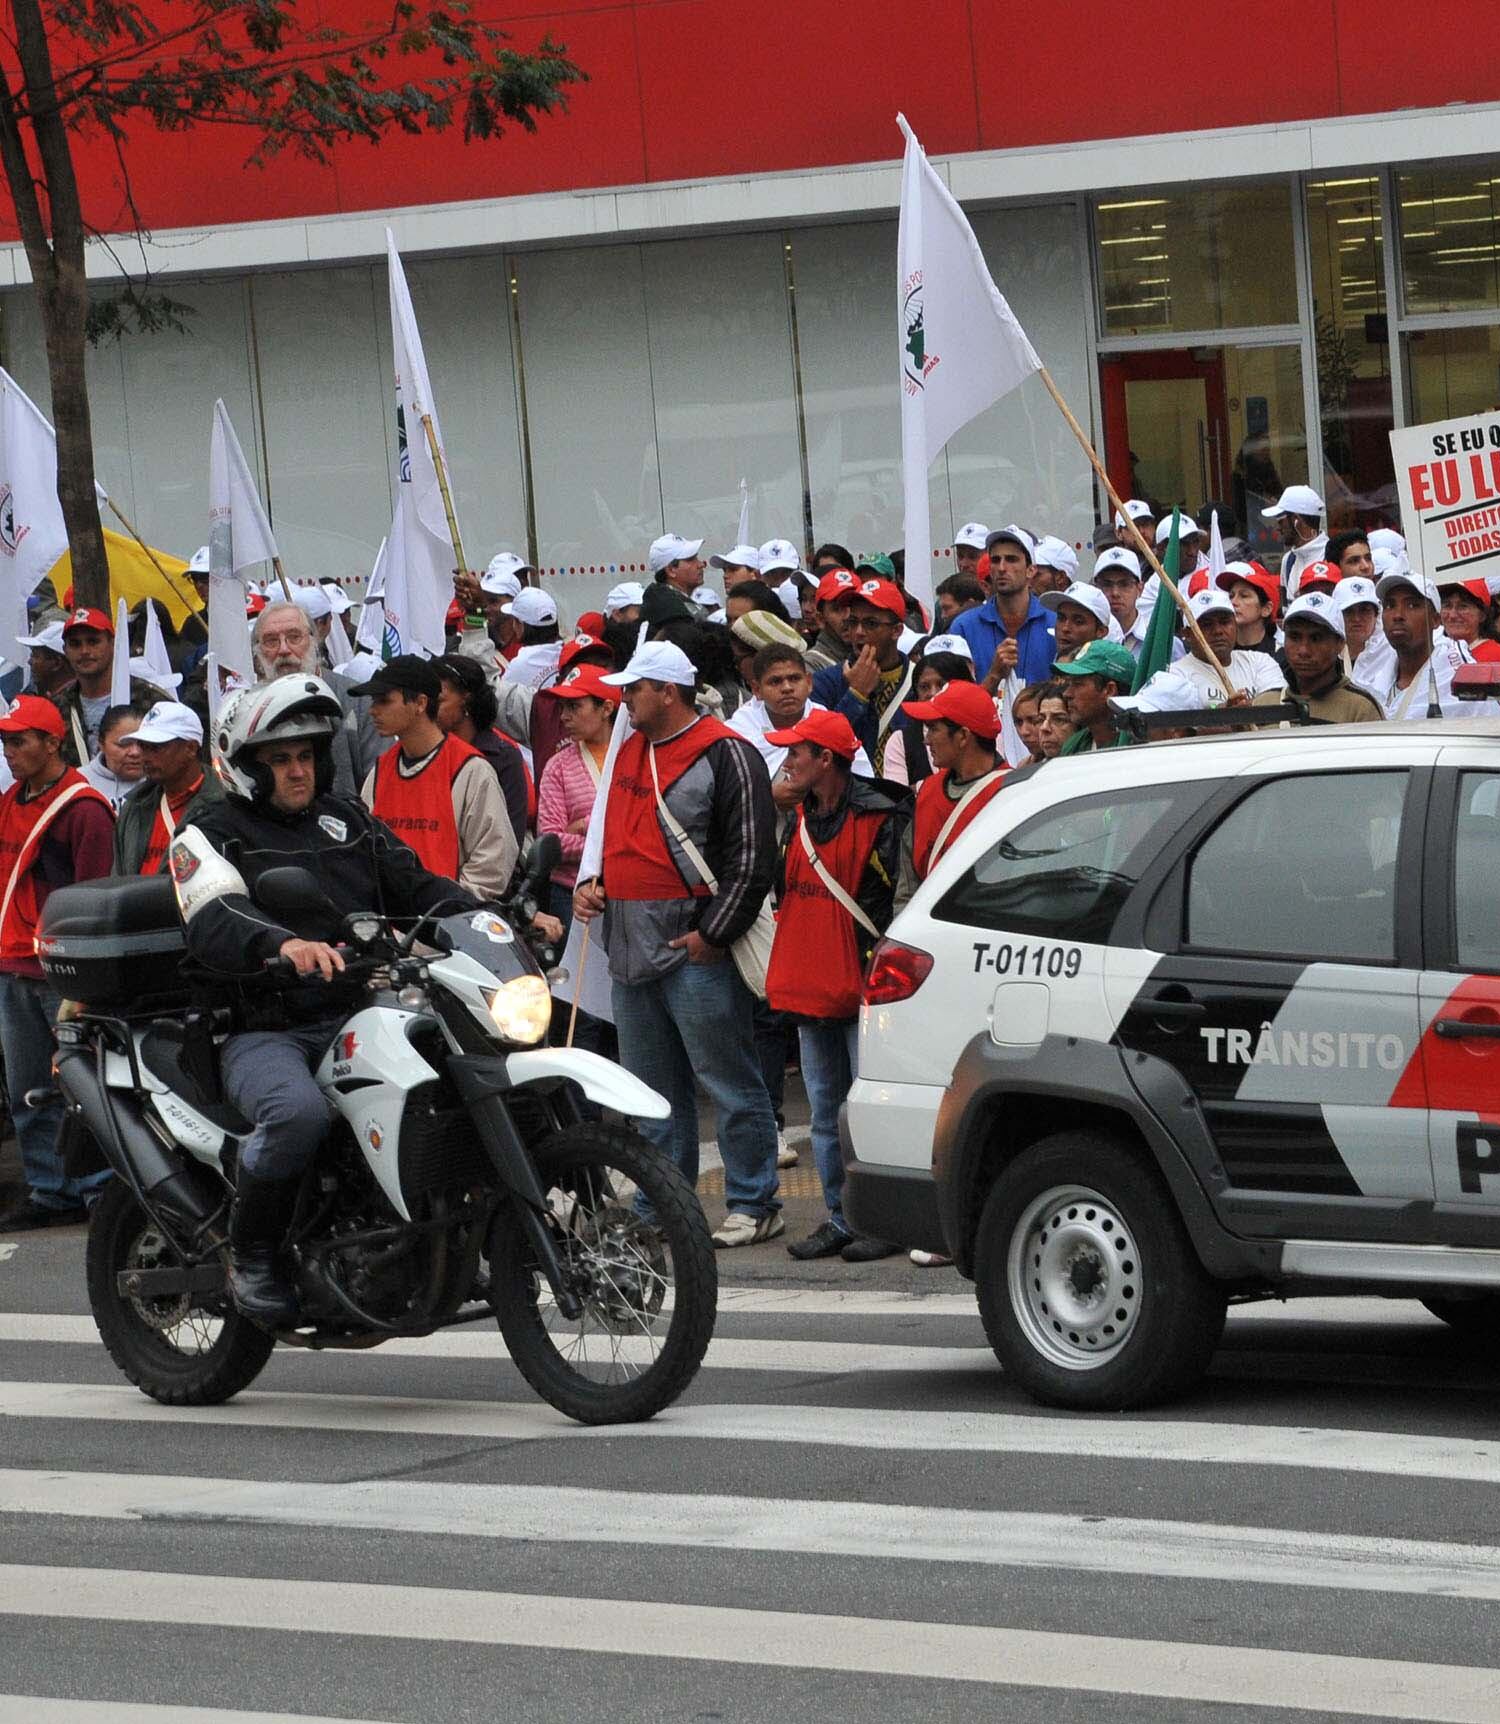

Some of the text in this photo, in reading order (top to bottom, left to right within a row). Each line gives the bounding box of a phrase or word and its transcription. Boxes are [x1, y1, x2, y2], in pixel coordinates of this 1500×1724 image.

[1432, 433, 1457, 456] SE
[1461, 427, 1485, 451] EU
[1408, 459, 1461, 511] EU
[972, 942, 1083, 979] T-01109
[1200, 1020, 1405, 1070] TRÂNSITO
